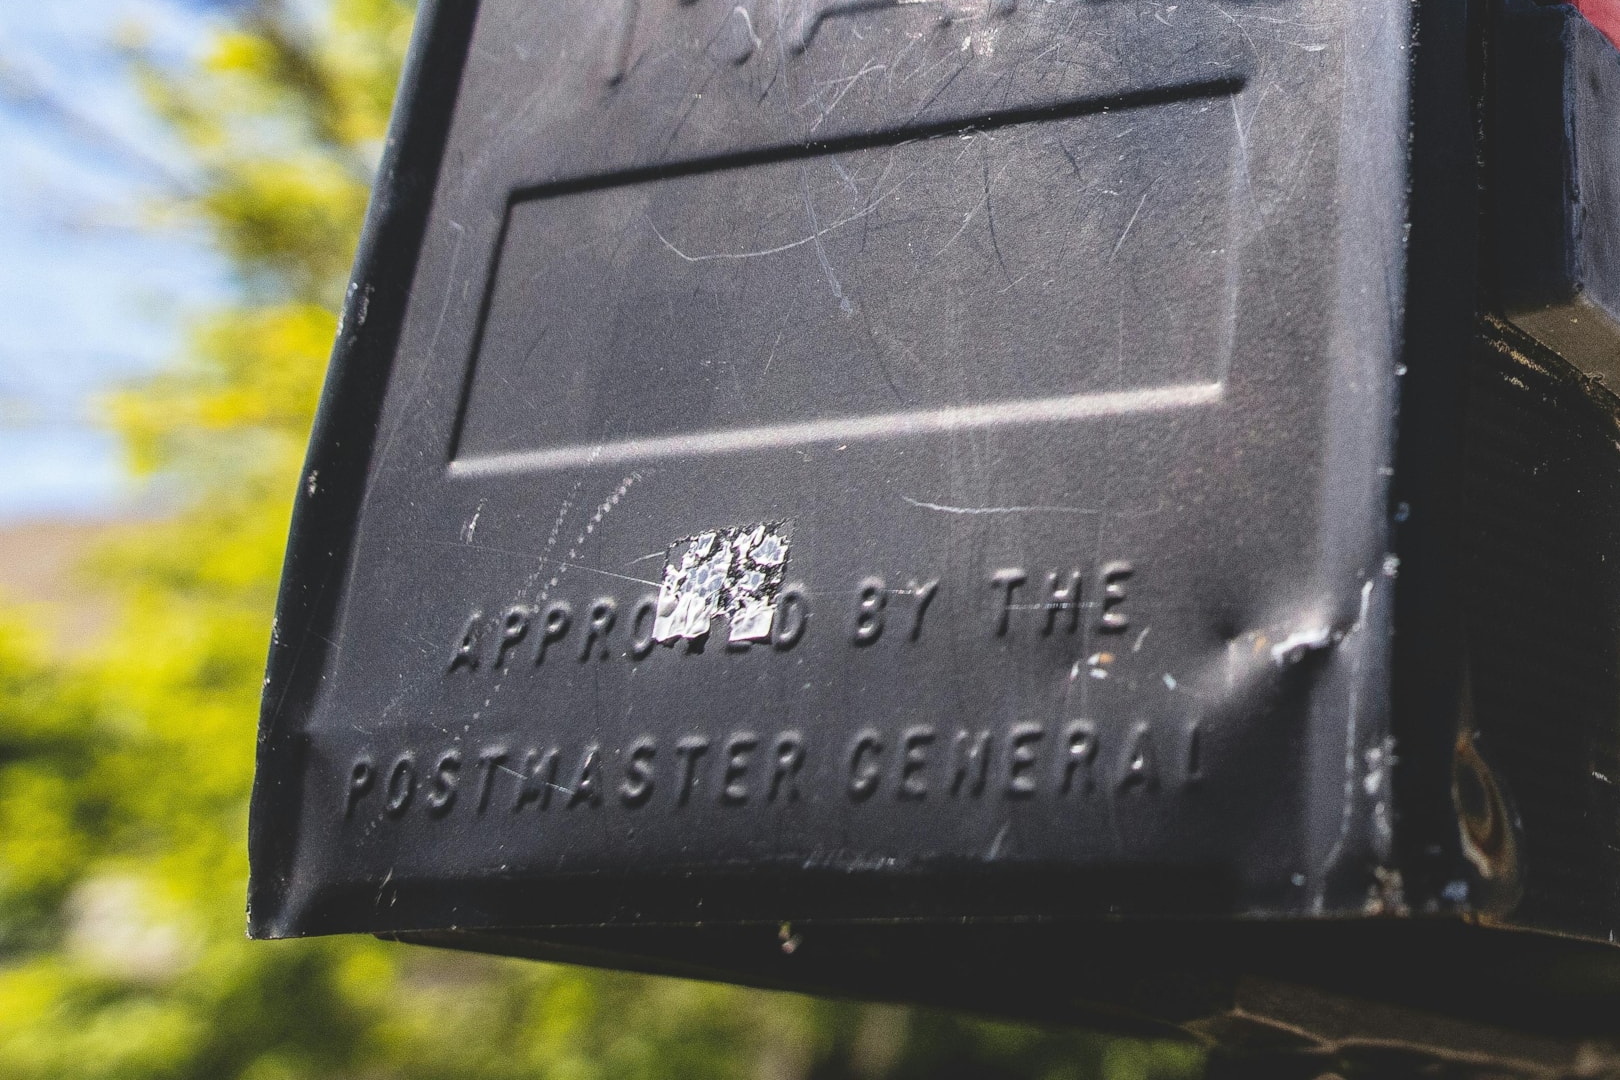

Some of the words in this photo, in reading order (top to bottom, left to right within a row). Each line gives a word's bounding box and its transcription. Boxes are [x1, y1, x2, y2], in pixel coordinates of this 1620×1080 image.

[447, 582, 808, 673] APPROD
[853, 575, 941, 647] BY
[990, 560, 1134, 640] THE
[345, 727, 803, 820] POSTMASTER
[848, 718, 1208, 805] GENERAL
